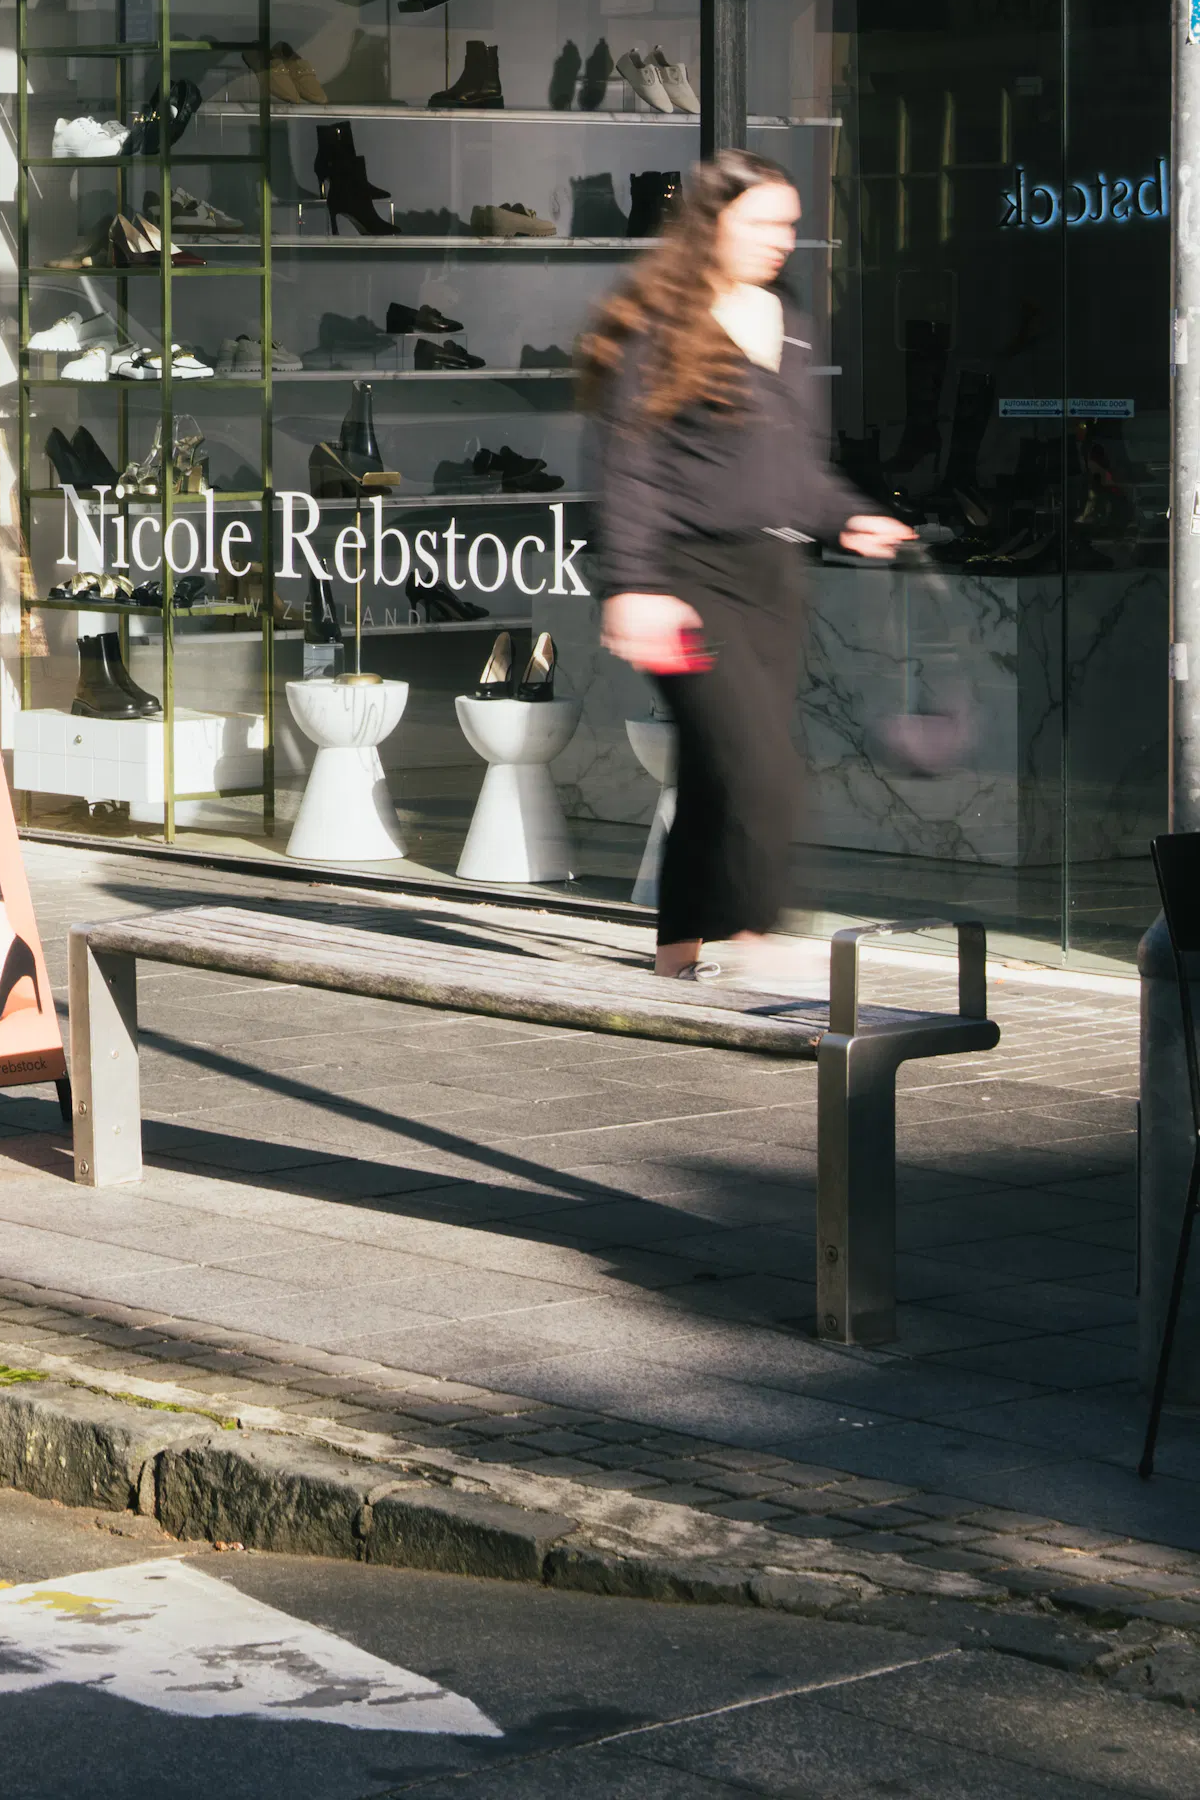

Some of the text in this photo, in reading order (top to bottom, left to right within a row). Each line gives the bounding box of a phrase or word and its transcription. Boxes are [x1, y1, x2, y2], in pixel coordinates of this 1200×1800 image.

[56, 483, 591, 597] Nicole Rebstock
[204, 595, 422, 628] NEW ZEALAND
